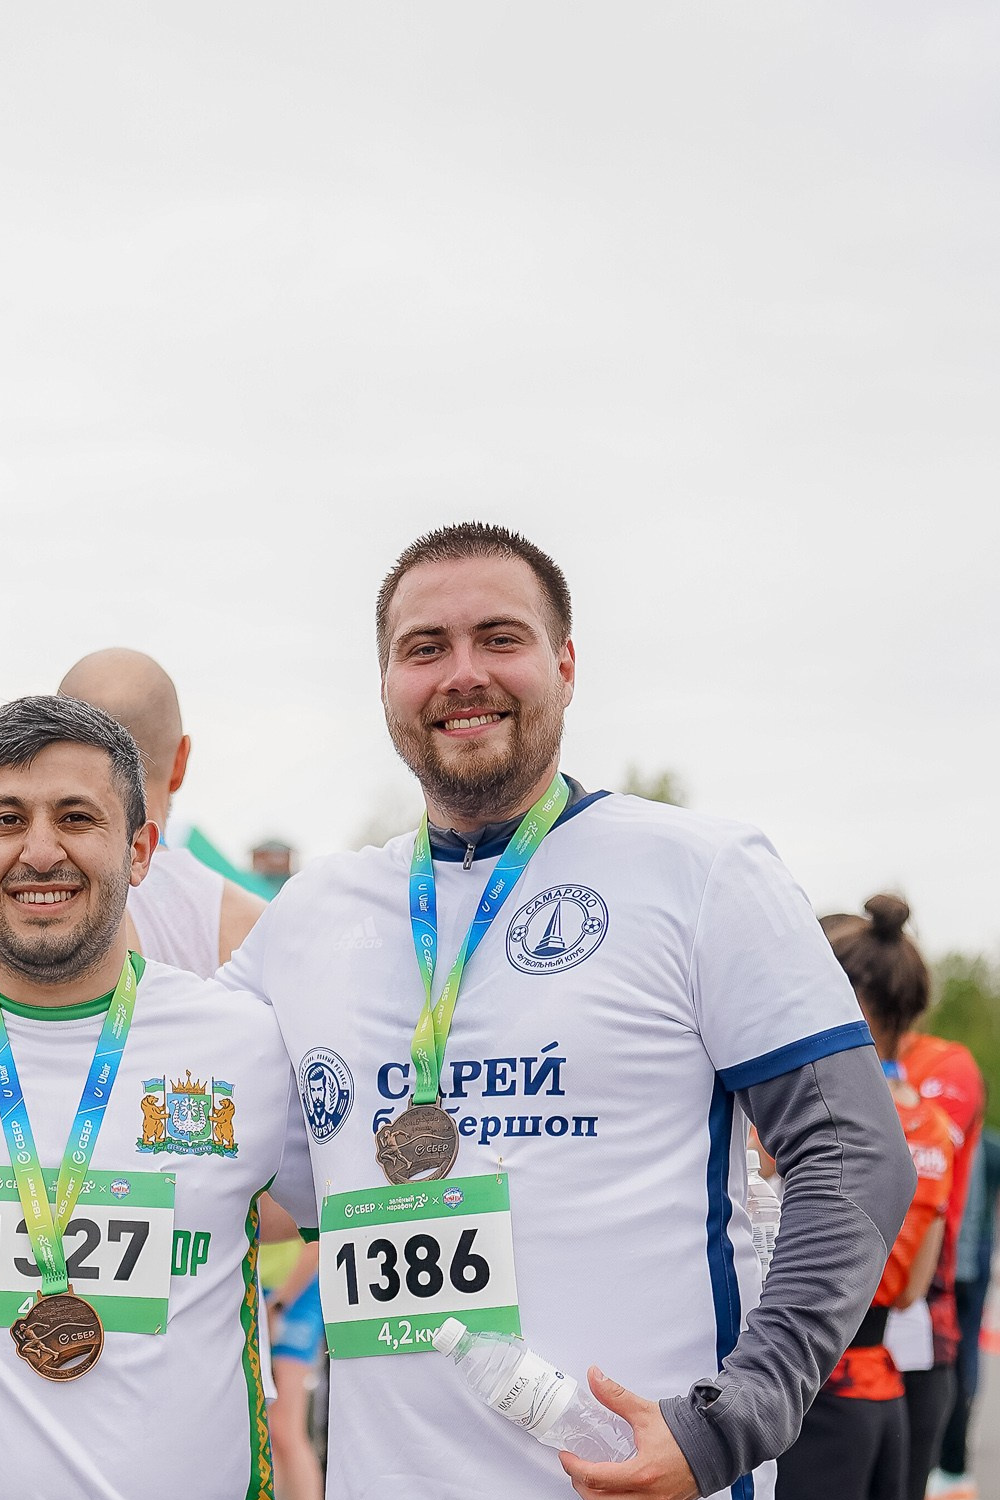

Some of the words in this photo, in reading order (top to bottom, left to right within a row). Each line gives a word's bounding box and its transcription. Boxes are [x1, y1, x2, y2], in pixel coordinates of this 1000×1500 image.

[542, 798, 555, 813] 185
[489, 878, 506, 900] Utair
[418, 893, 429, 912] Utair
[525, 888, 598, 916] САМАРОВО
[423, 949, 433, 977] СБЕР
[517, 953, 564, 969] ФУТБОЛЬНЫЙ
[564, 946, 585, 963] КЛУБ
[97, 1063, 111, 1085] Utair
[377, 1041, 567, 1100] СРЕЙ
[11, 1120, 26, 1149] СБЕР
[78, 1119, 93, 1149] СБЕР
[372, 1106, 599, 1145] бершоп
[426, 1144, 449, 1153] СБЕР
[26, 1177, 37, 1198] лет
[57, 1199, 69, 1219] 185
[65, 1177, 76, 1198] лет
[31, 1199, 42, 1220] 185
[354, 1203, 376, 1214] СБЕР
[336, 1228, 490, 1306] 1386
[70, 1330, 95, 1341] СБЕР
[377, 1320, 413, 1350] 4,2
